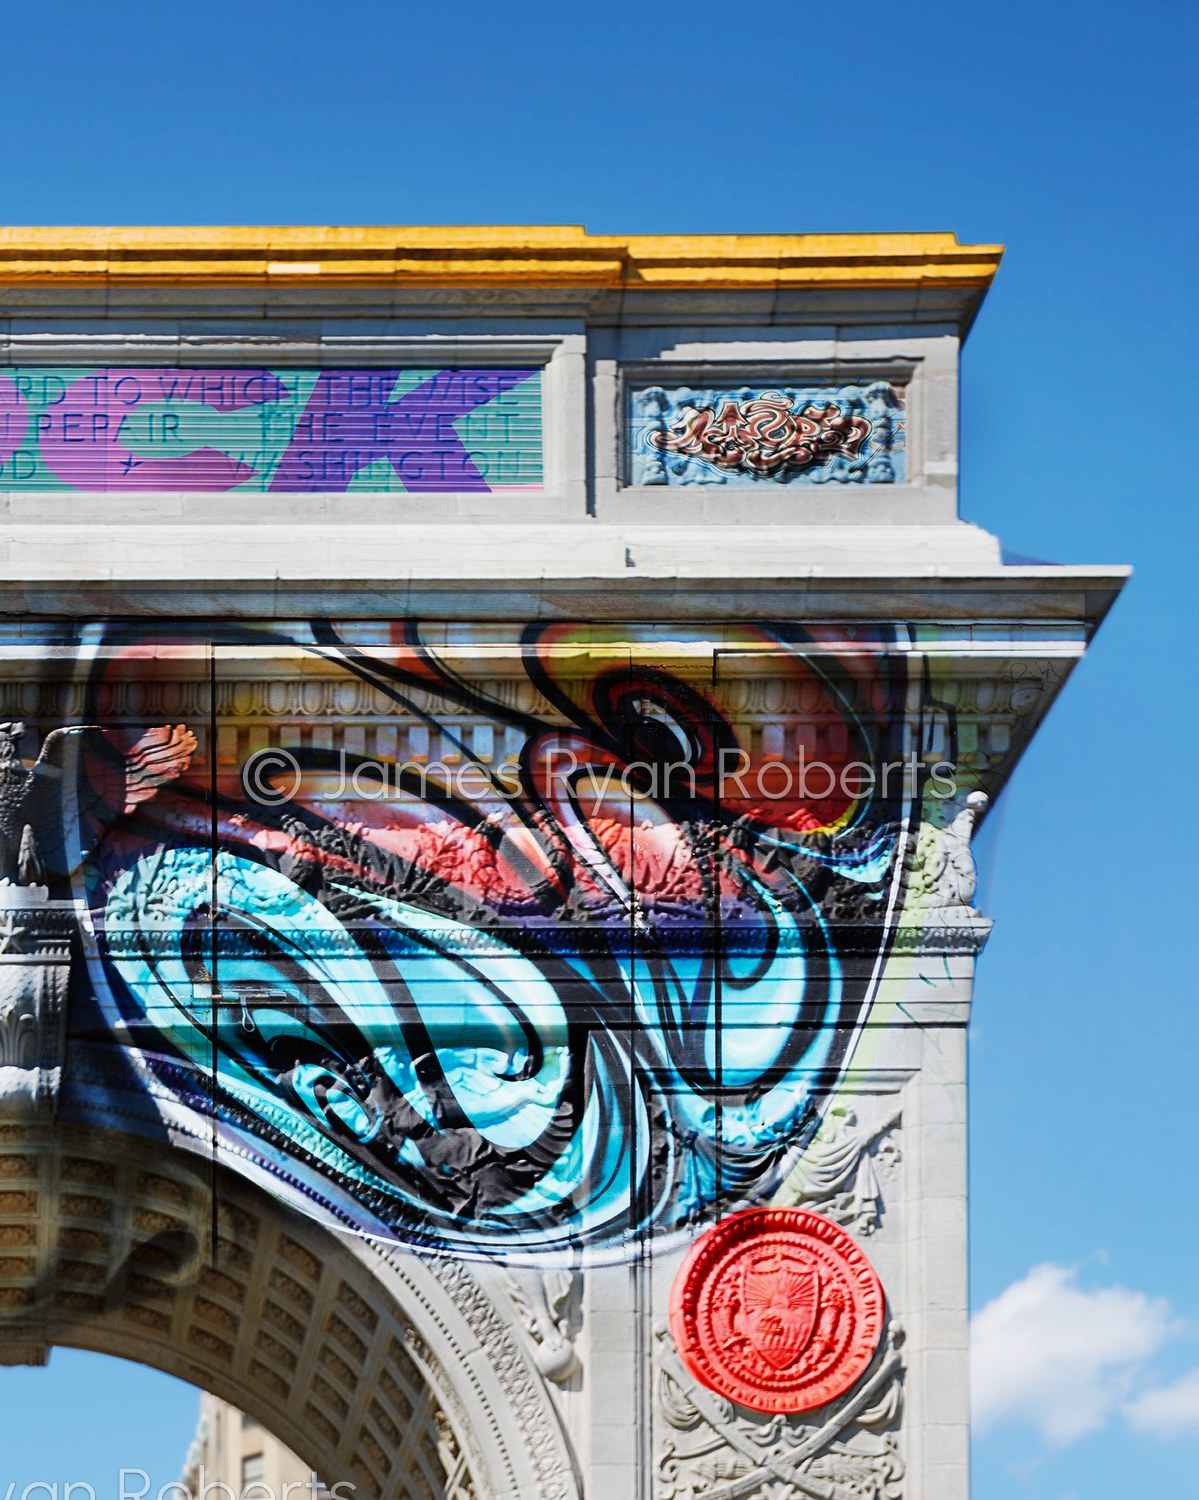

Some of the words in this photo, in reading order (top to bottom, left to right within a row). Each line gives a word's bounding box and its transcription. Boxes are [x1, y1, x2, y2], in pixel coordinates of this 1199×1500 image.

[85, 375, 142, 405] TO
[158, 375, 299, 405] WHICH
[319, 375, 400, 406] THE
[417, 375, 520, 405] WISE
[34, 413, 184, 442] REPAIR
[257, 412, 344, 443] THE
[373, 413, 520, 443] EVENT
[224, 450, 521, 480] WASHINGTON
